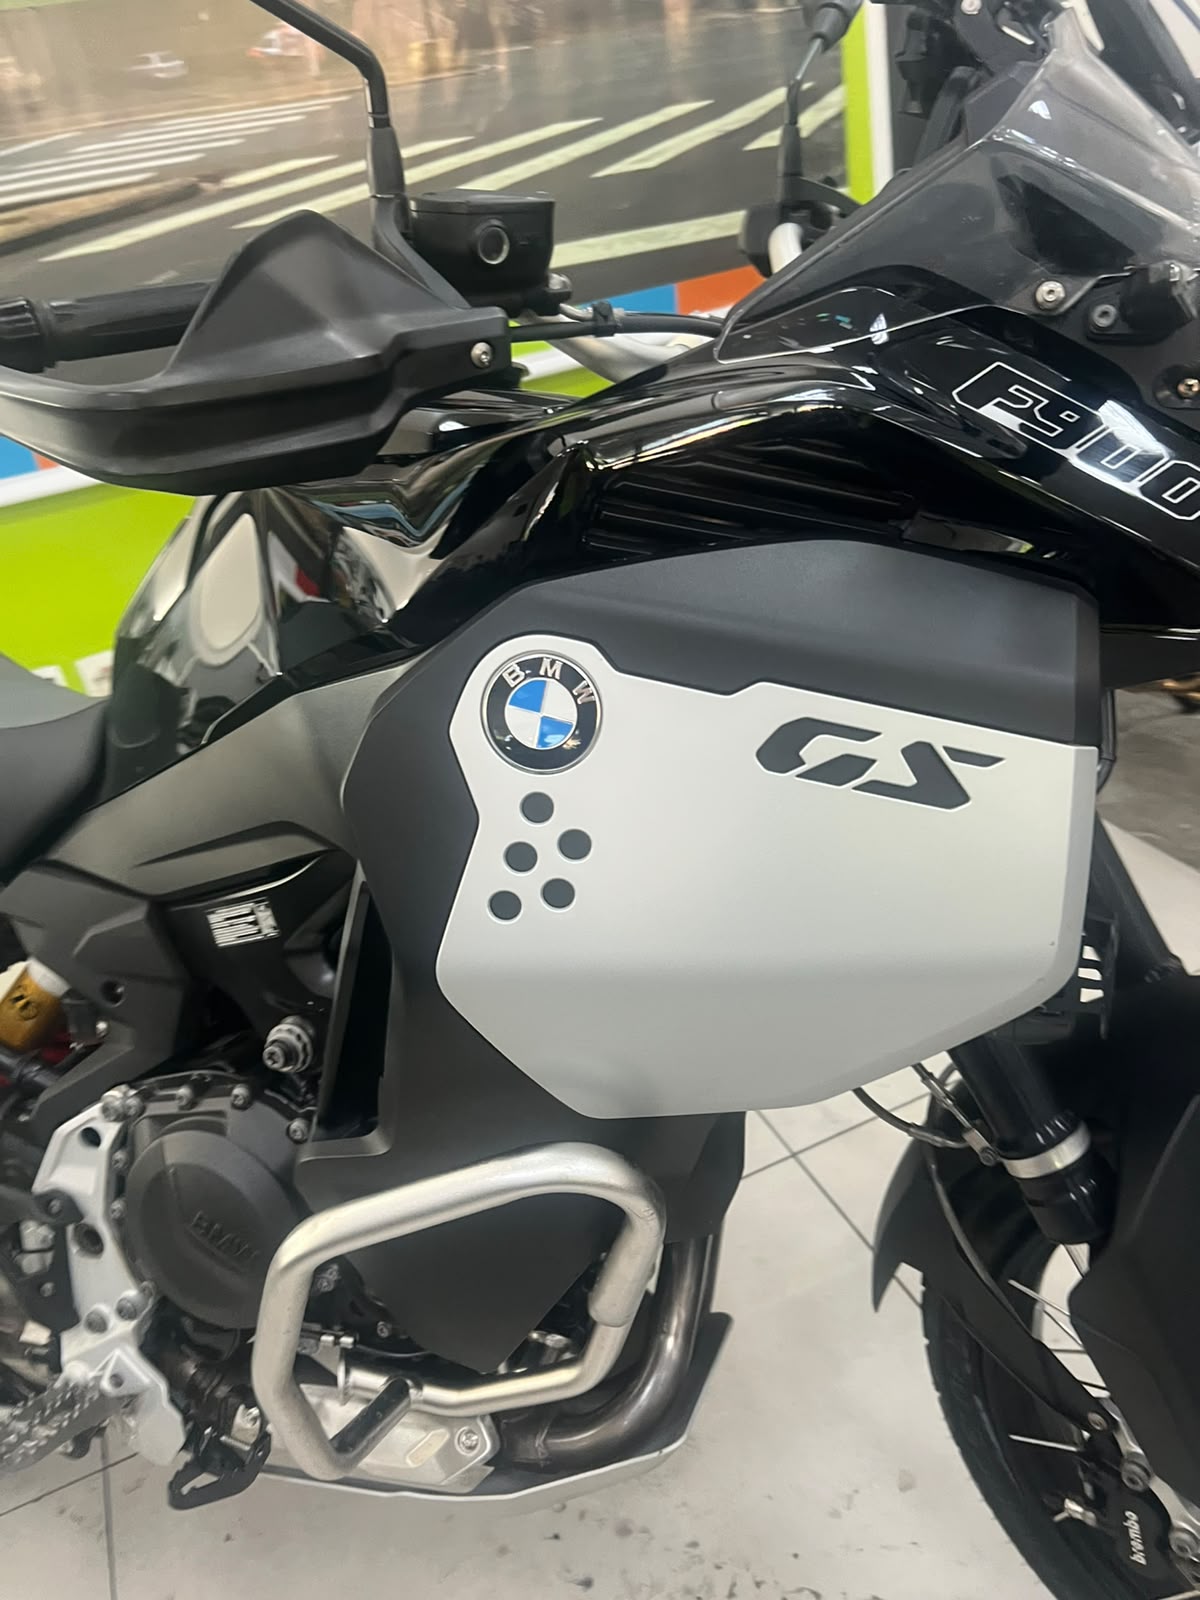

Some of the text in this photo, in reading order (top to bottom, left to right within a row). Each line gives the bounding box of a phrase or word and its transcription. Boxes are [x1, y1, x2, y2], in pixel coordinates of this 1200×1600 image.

[502, 656, 596, 705] BMW
[755, 716, 1006, 811] GS
[190, 1208, 262, 1262] BMW
[1122, 1510, 1147, 1566] brembo
